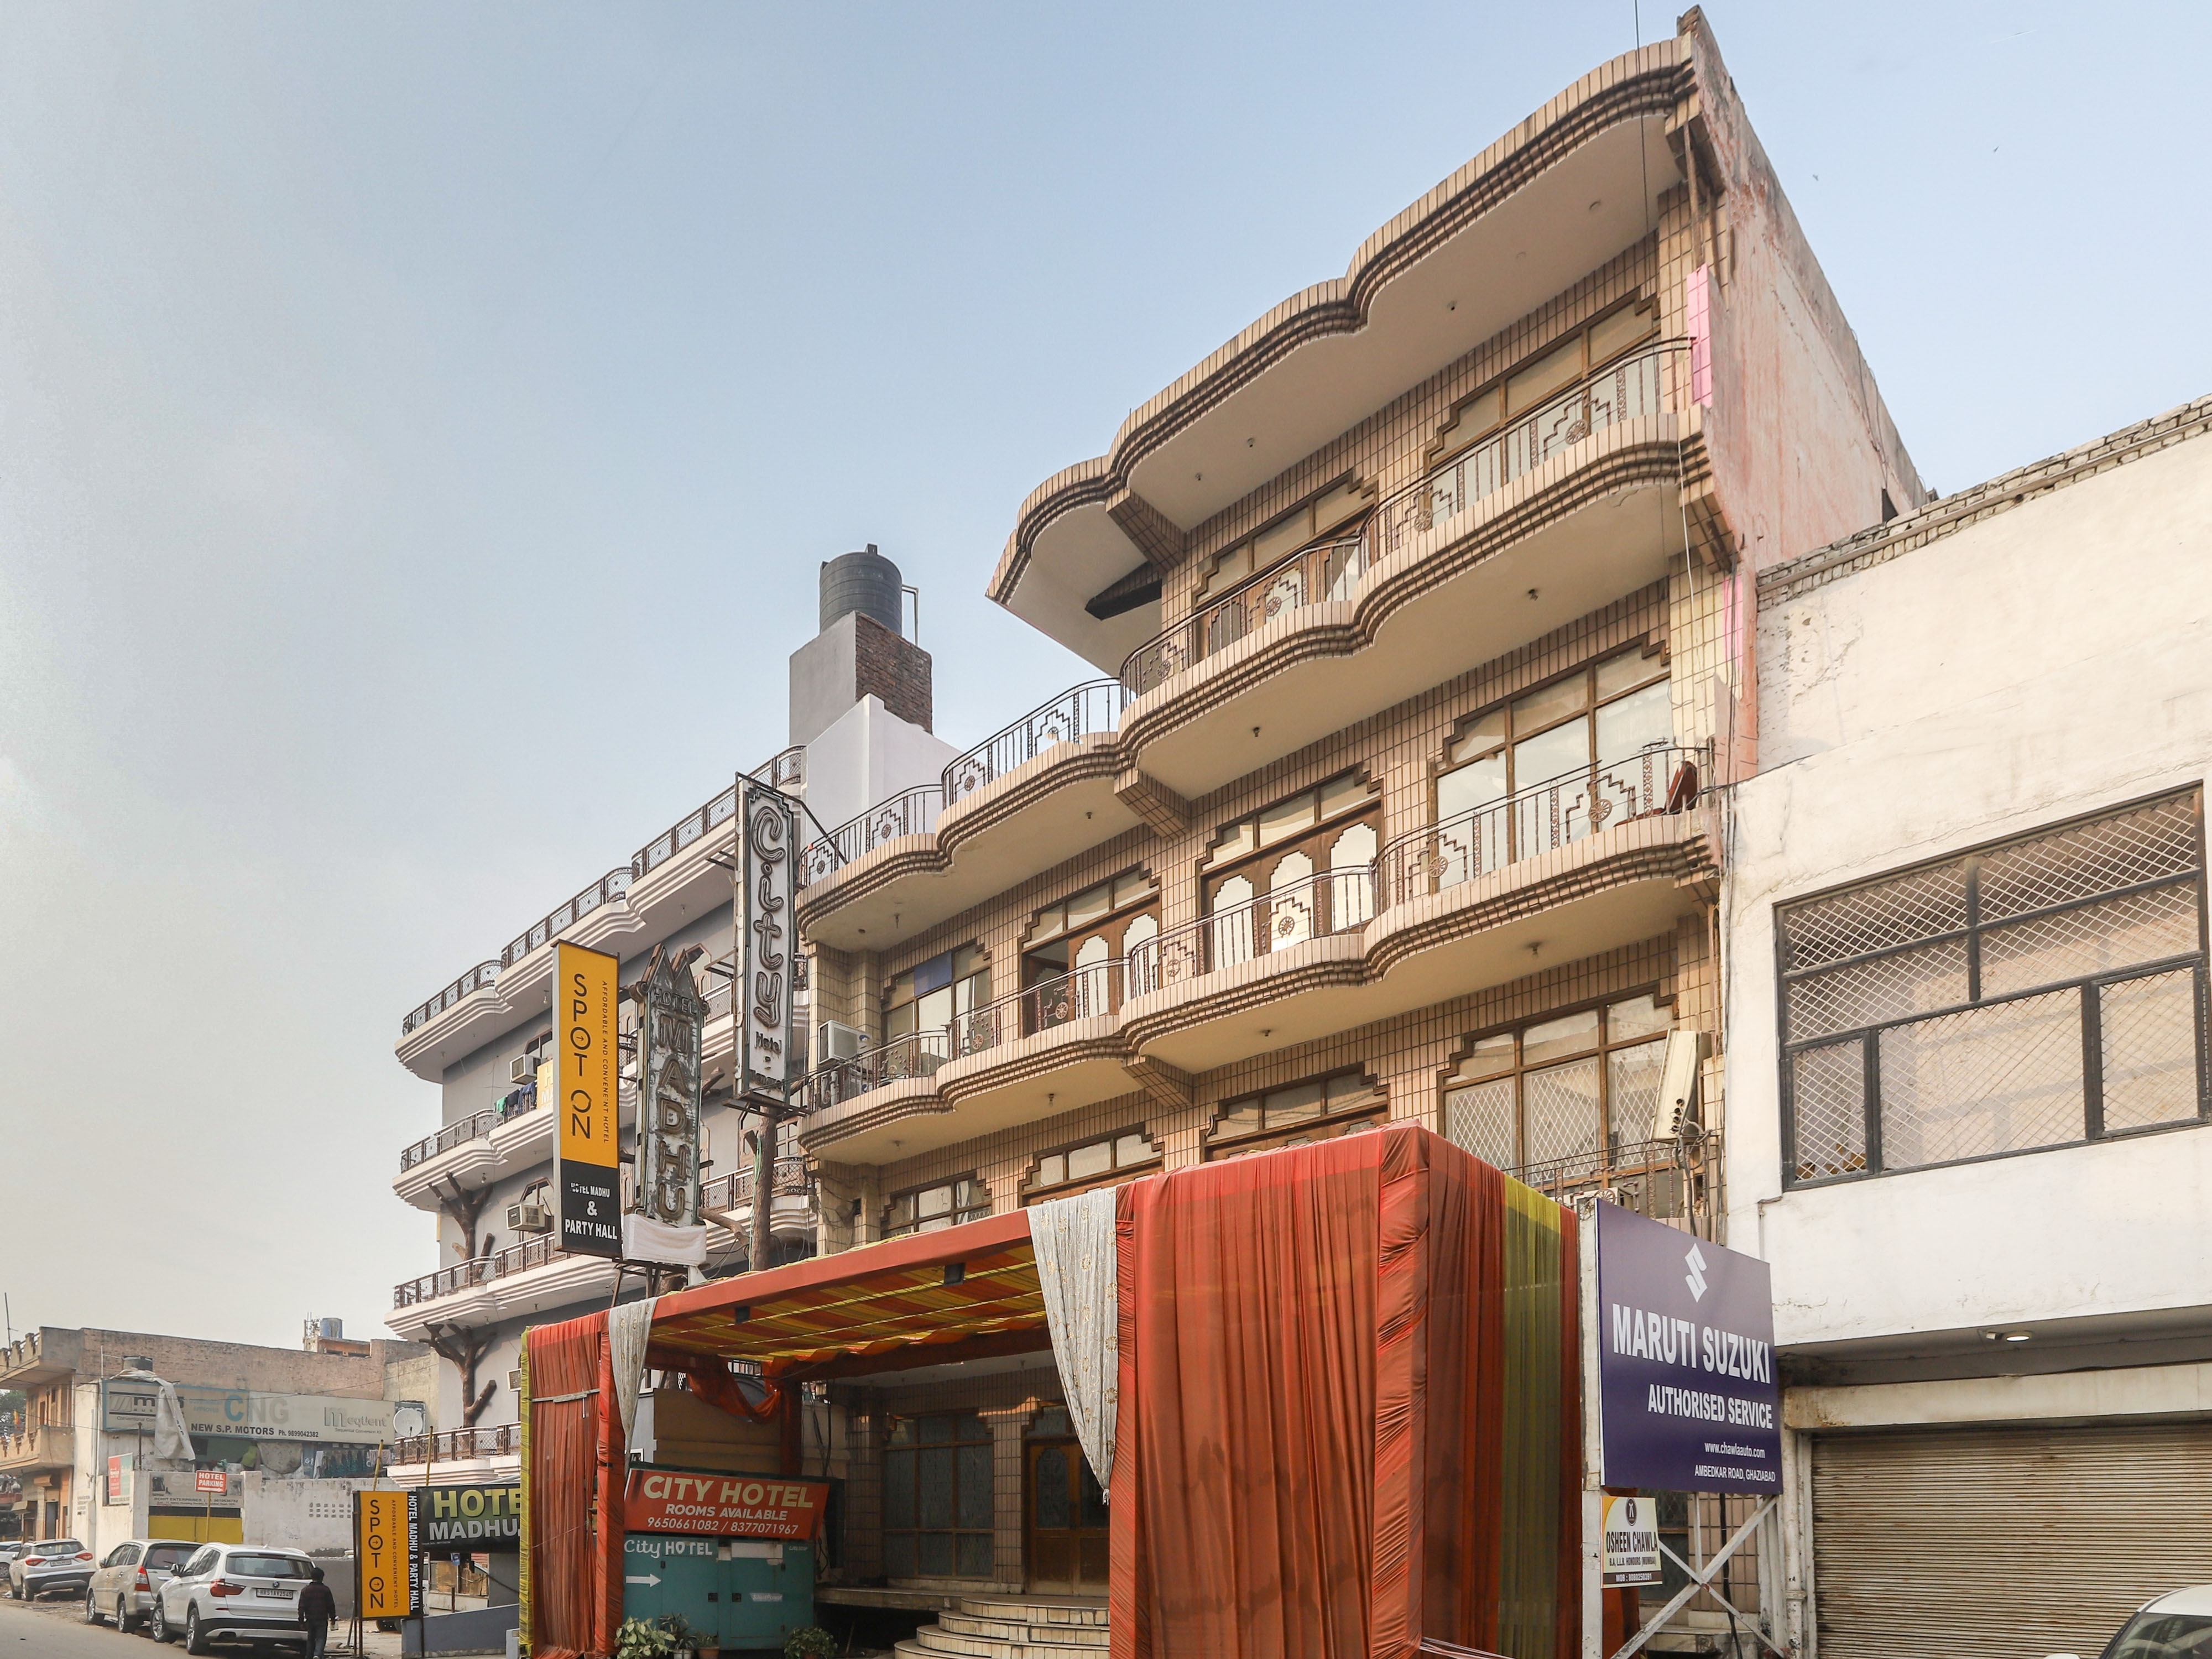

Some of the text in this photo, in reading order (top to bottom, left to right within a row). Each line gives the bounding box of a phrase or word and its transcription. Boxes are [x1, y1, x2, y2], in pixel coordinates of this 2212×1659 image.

[752, 805, 785, 1028] City
[653, 987, 697, 1015] HOTEL
[570, 973, 591, 1077] SPOT
[658, 1014, 690, 1220] MADHU
[590, 1186, 610, 1198] MADHU
[587, 1201, 598, 1216] &
[565, 1219, 618, 1240] PARTY HALL
[1613, 1303, 1771, 1384] MARUTI SUZUKI
[225, 1394, 289, 1425] CNG
[1648, 1384, 1773, 1430] AUTHORISED SERVICE
[191, 1423, 213, 1432] NEW
[216, 1425, 232, 1433] S.P.
[235, 1426, 274, 1435] MOTORS
[1704, 1442, 1766, 1458] www.chawlaauto.com
[1694, 1465, 1776, 1482] AMBEDKAR ROAD, GHAZIABAD
[433, 1488, 520, 1518] HOTE
[644, 1475, 813, 1508] CITY HOTEL
[408, 1495, 417, 1521] HOTEL
[666, 1504, 788, 1520] ROOMS AVAILABLE
[409, 1523, 418, 1551] MADHU
[429, 1519, 518, 1541] MADHU
[648, 1517, 799, 1534] 9650661082 / 8377071967
[368, 1499, 384, 1609] SPOT ON
[624, 1539, 713, 1558] City HOTEL
[1606, 1531, 1658, 1553] OSHEEN CHAWLA
[409, 1563, 419, 1588] PARTY
[410, 1590, 419, 1611] HALL
